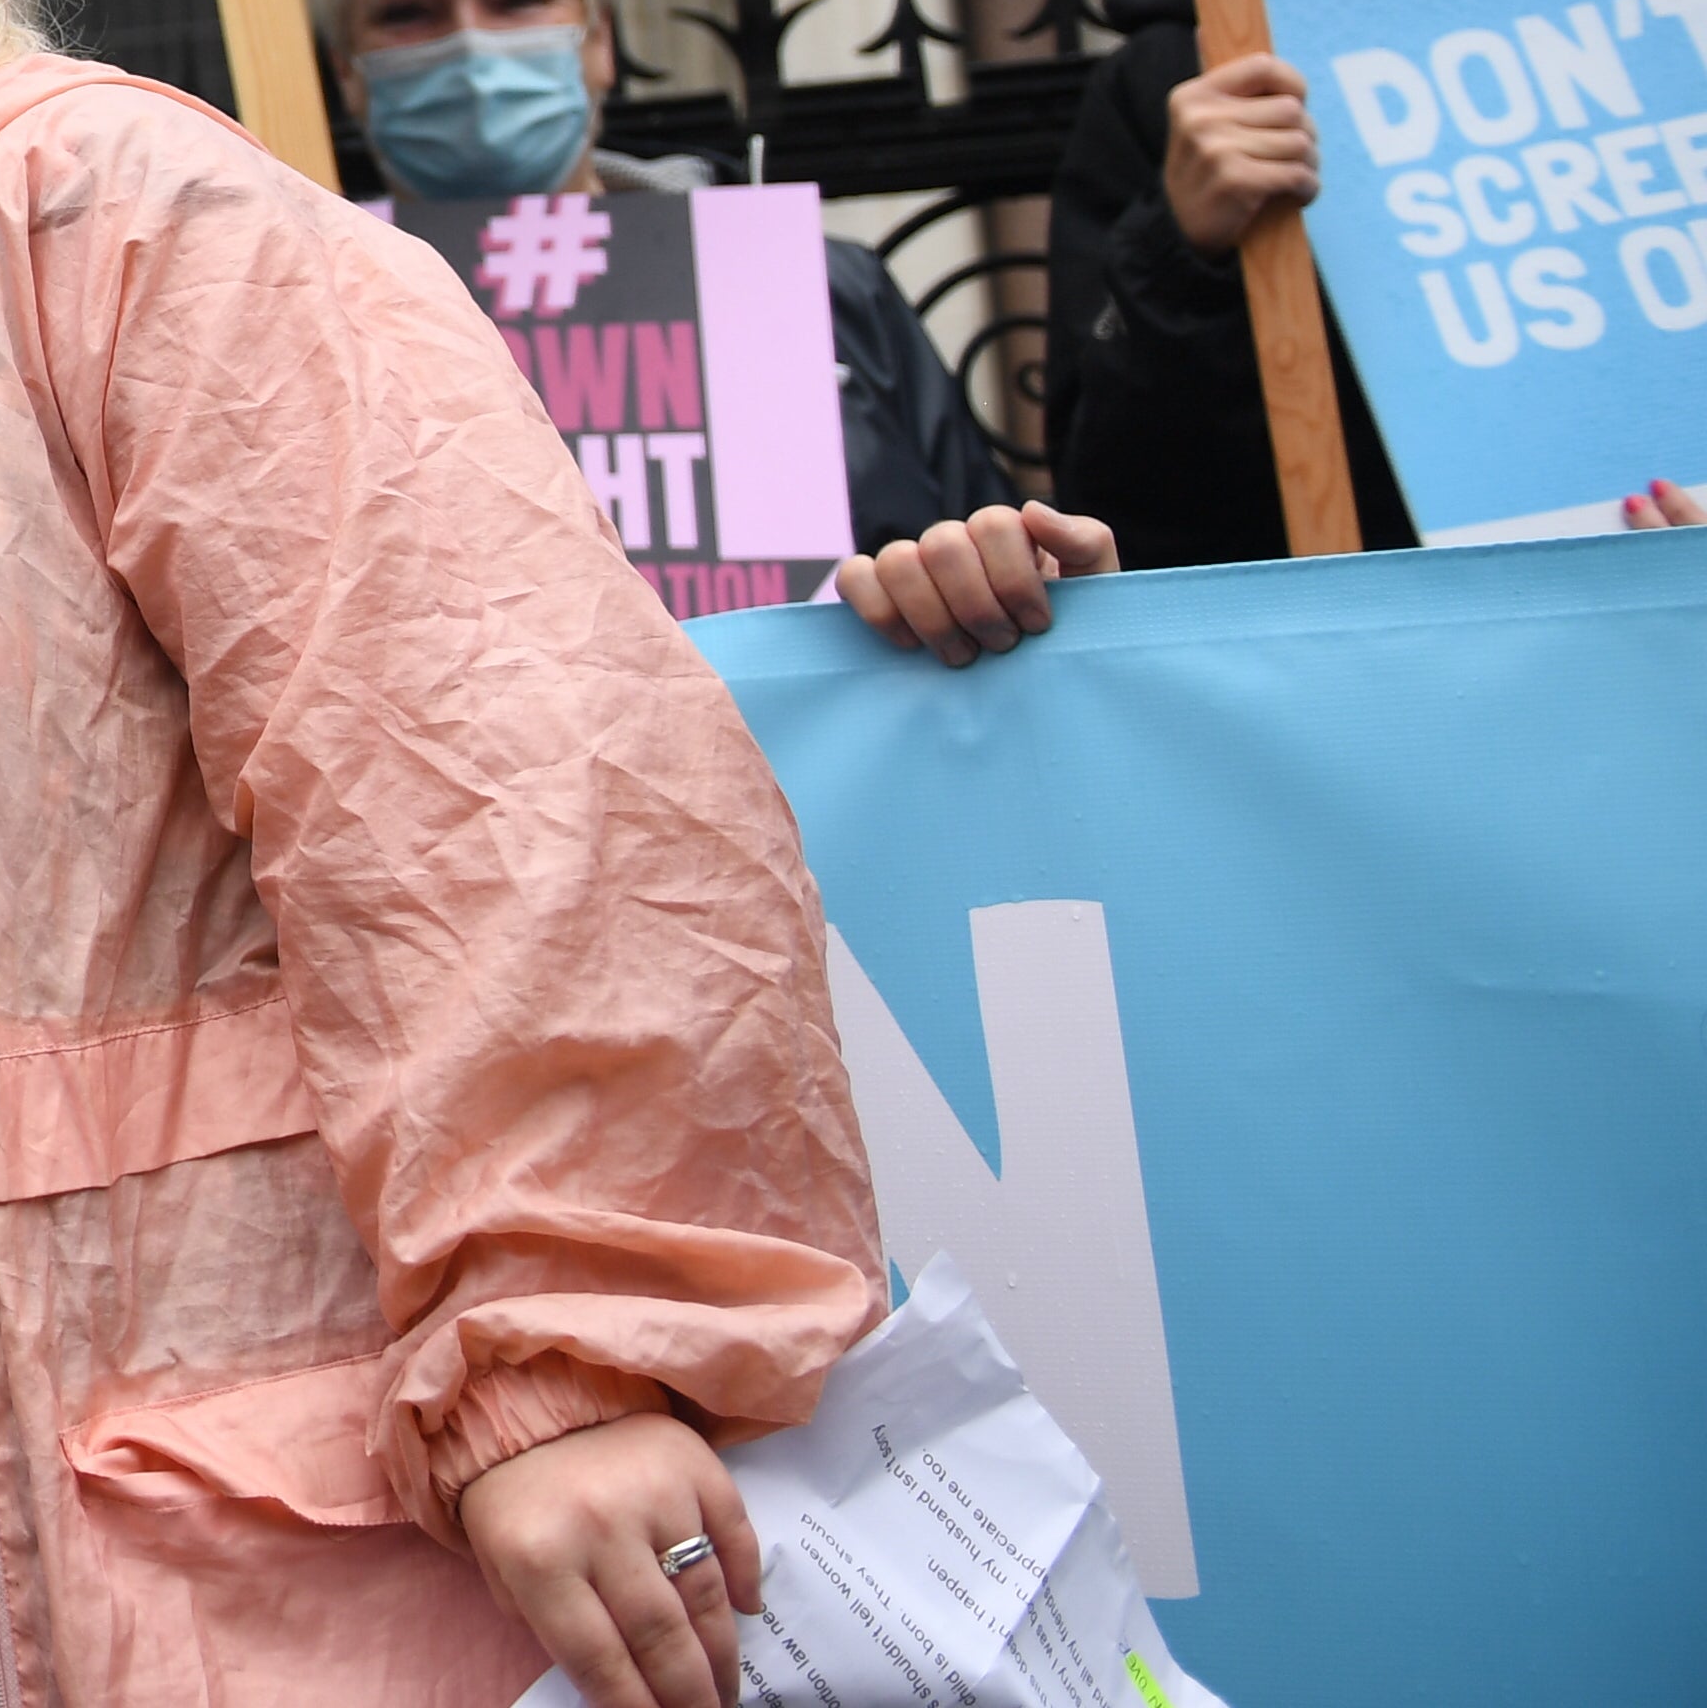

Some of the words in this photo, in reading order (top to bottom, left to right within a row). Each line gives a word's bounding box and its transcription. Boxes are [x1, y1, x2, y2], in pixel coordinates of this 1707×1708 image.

[1419, 246, 1605, 369] US
[887, 1458, 920, 1494] isn't
[922, 1448, 950, 1482] too.
[947, 1481, 972, 1509] me
[801, 1514, 854, 1565] should
[917, 1490, 983, 1562] husband
[800, 1537, 852, 1599] women
[985, 1559, 1008, 1586] my
[857, 1566, 893, 1611] They
[927, 1554, 989, 1621] happen.
[850, 1599, 875, 1629] tell
[900, 1608, 935, 1656] born.
[1043, 1587, 1069, 1642] friends
[781, 1638, 810, 1670] law
[1036, 1625, 1054, 1656] was
[1067, 1641, 1083, 1667] my
[871, 1625, 931, 1700] shouldn't
[933, 1652, 950, 1674] is
[1080, 1666, 1095, 1688] all
